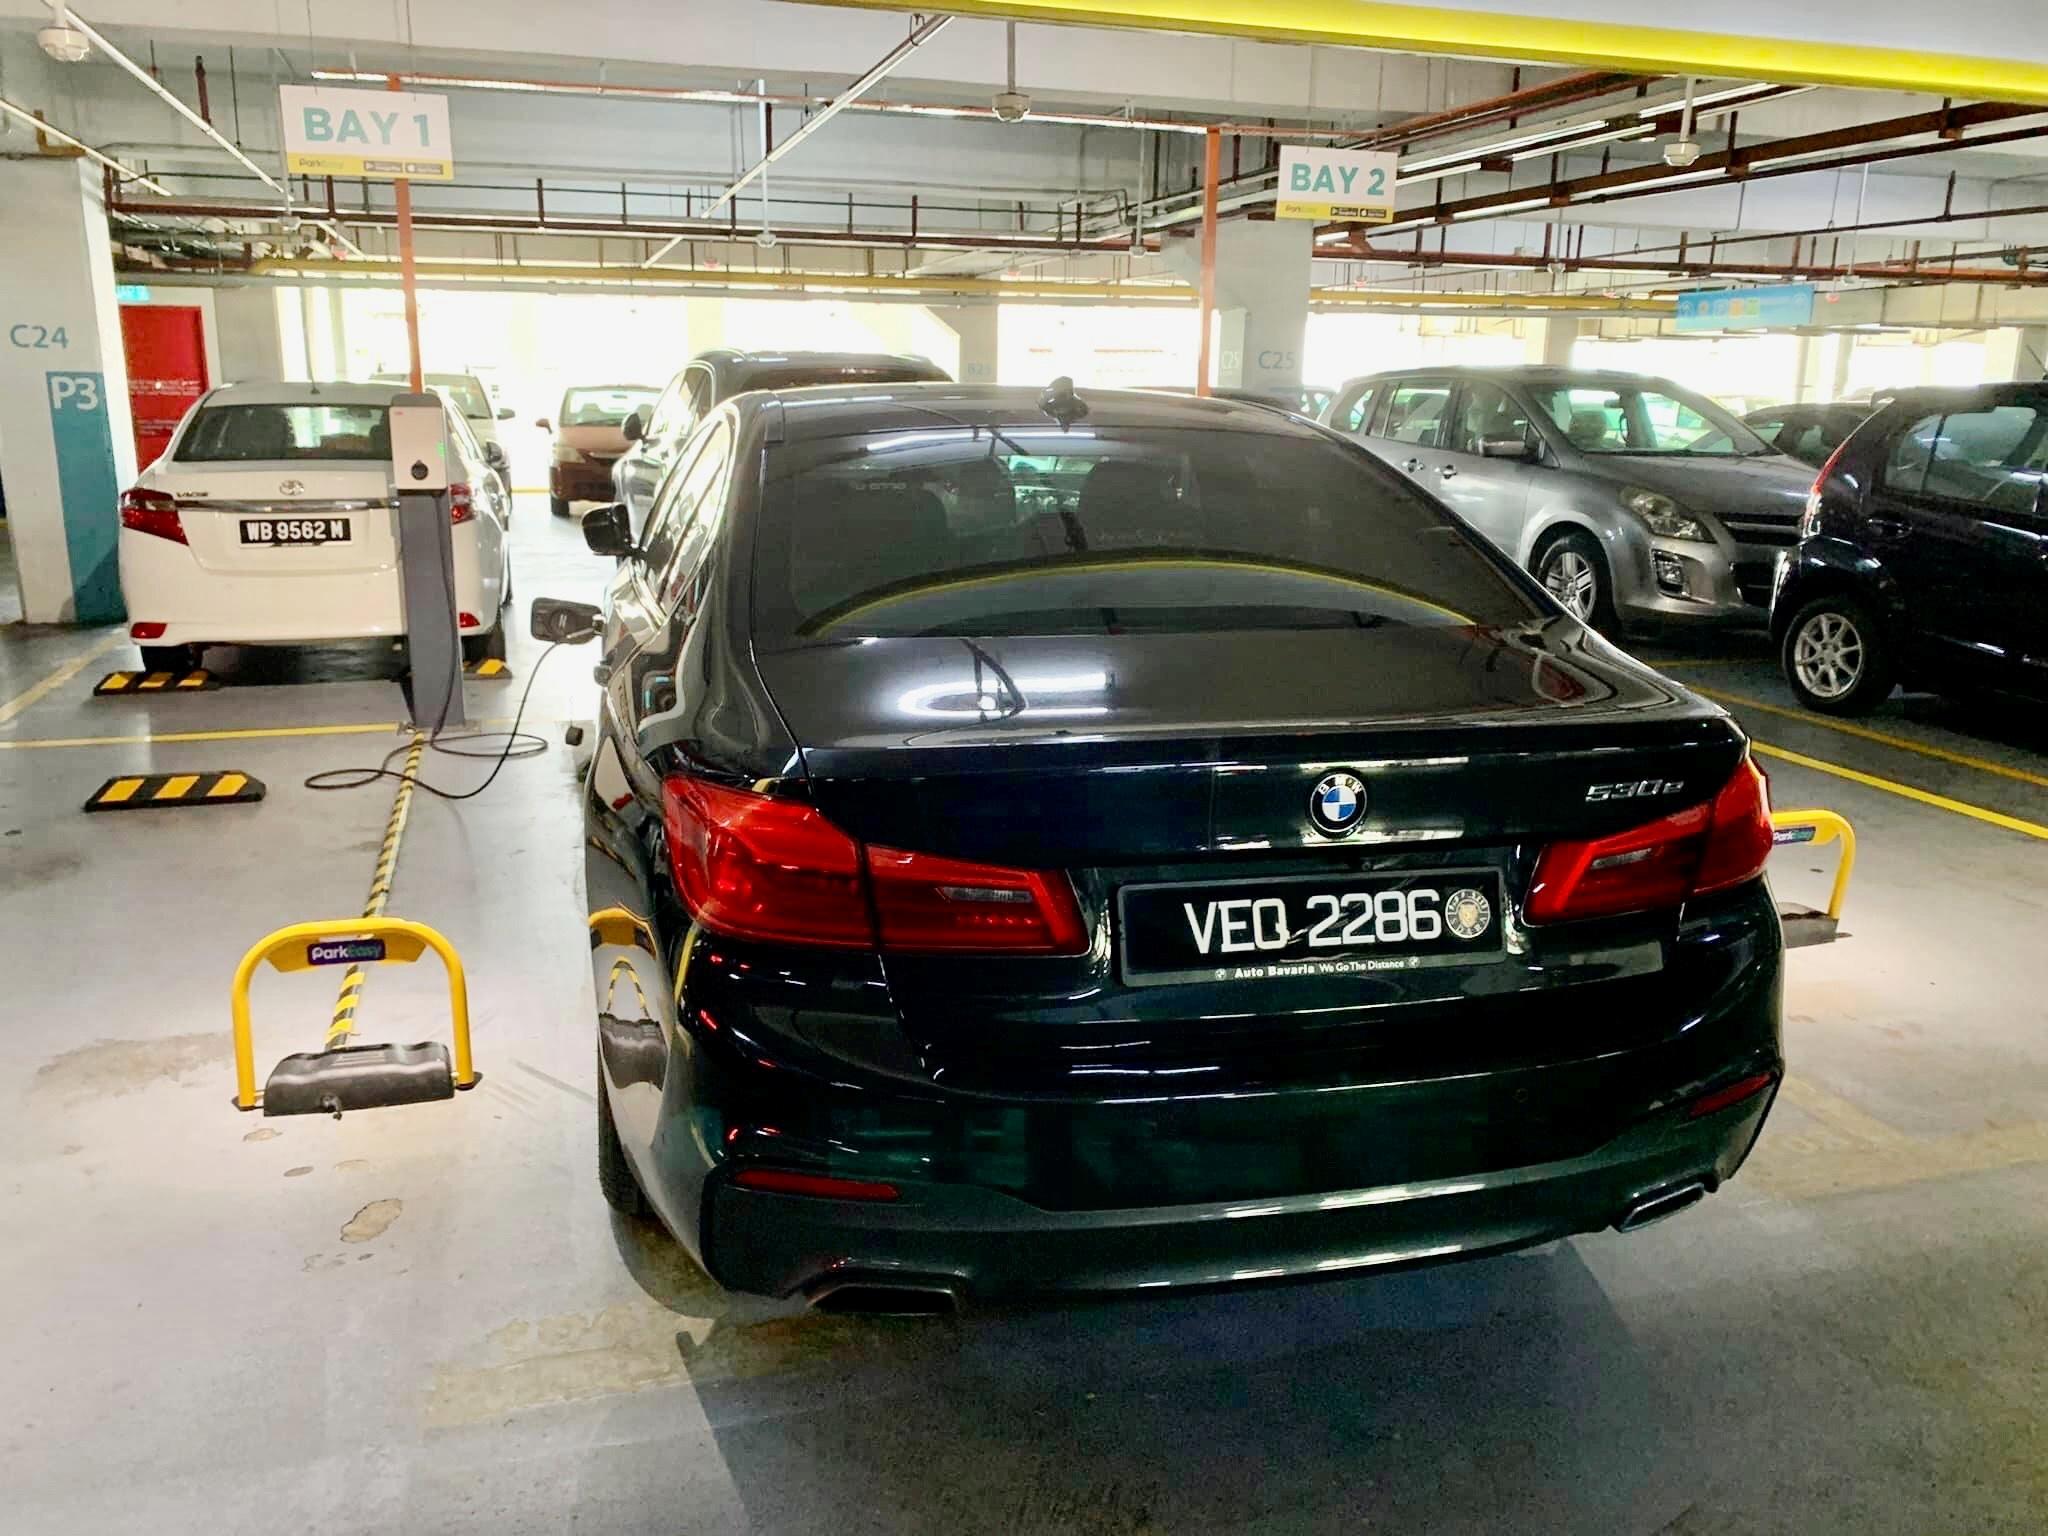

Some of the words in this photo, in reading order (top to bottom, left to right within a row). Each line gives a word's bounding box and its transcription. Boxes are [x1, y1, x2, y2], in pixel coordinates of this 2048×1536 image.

[302, 107, 400, 145] BAY
[413, 113, 430, 147] 1
[1290, 163, 1359, 194] BAY
[1367, 168, 1385, 196] 2
[10, 324, 69, 349] C24
[1258, 350, 1295, 370] C25
[51, 376, 98, 410] P3
[246, 522, 273, 541] WB
[276, 520, 327, 540] 9562
[330, 519, 344, 539] M
[1585, 779, 1684, 802] 530e
[1183, 898, 1290, 954] VEQ
[1306, 889, 1442, 947] 2286
[1234, 967, 1264, 978] Auto
[1267, 963, 1315, 976] Bavaria
[1319, 963, 1334, 973] We
[1335, 962, 1350, 972] Go
[1349, 961, 1366, 971] The
[1367, 960, 1405, 970] Distance
